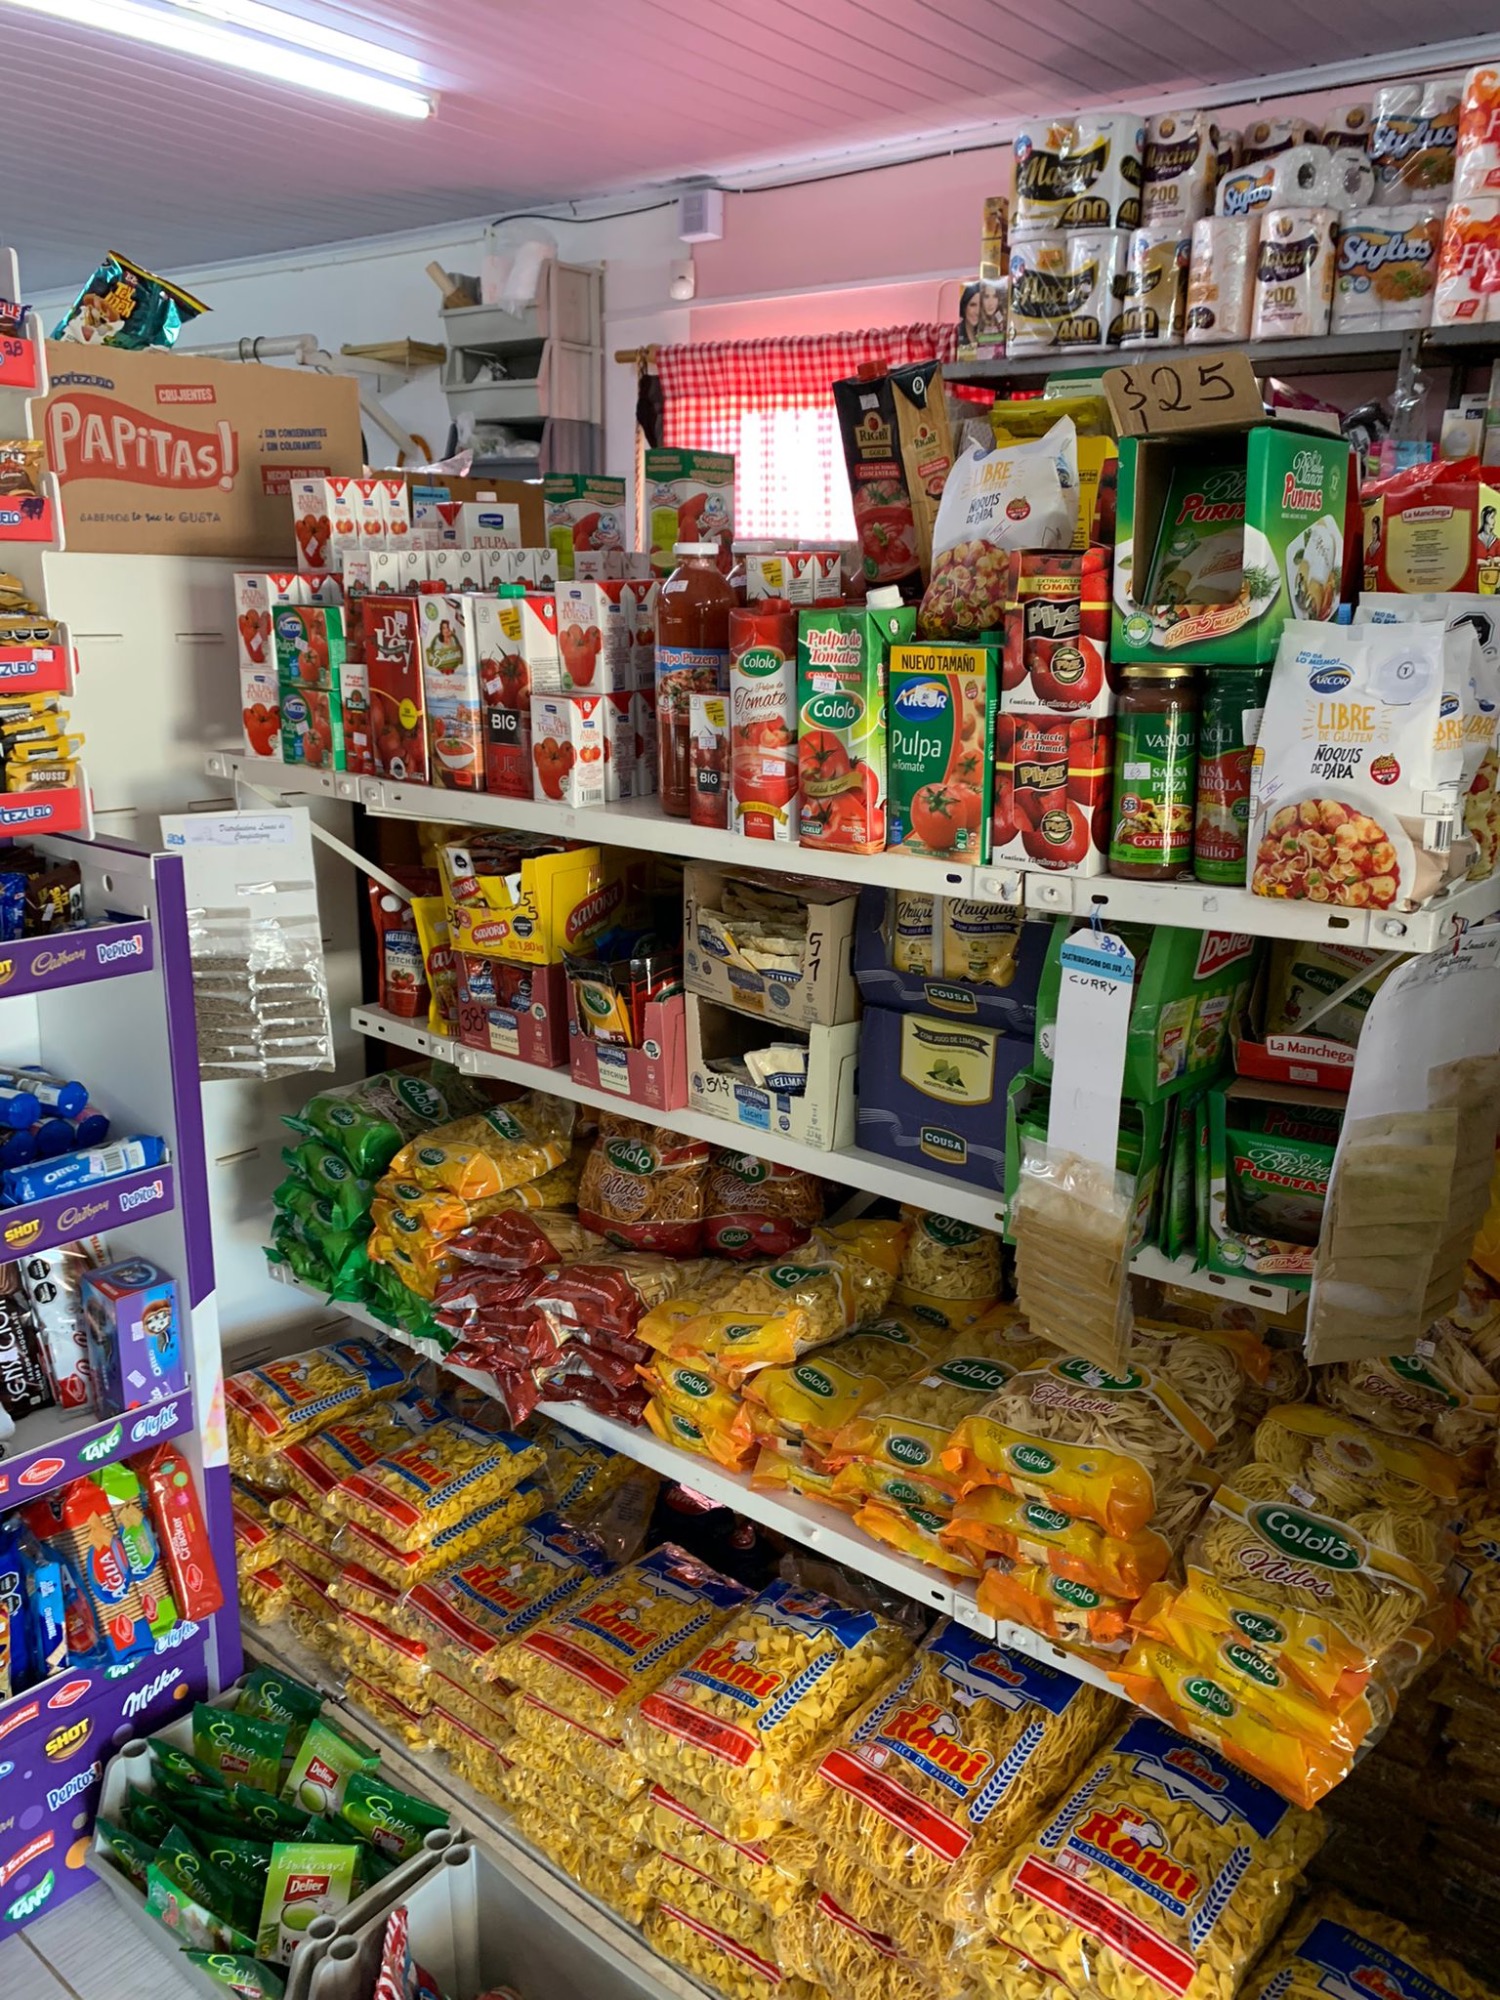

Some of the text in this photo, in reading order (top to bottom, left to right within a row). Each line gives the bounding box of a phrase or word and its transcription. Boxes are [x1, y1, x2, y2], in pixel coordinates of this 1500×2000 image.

[1149, 184, 1178, 201] 200
[1065, 200, 1108, 224] 400
[1339, 233, 1433, 271] Stylus
[1265, 286, 1297, 304] 200
[1059, 319, 1099, 341] 400
[158, 387, 214, 403] CRUJIENTES
[278, 428, 327, 437] CONSERVANTES
[280, 441, 322, 451] COLORANTES
[972, 461, 1014, 488] LIBRE
[1282, 472, 1323, 511] PURITAS
[179, 512, 222, 523] GUSTA
[806, 629, 861, 652] Pulpa de
[660, 651, 720, 666] Tipo Pizzera
[742, 652, 777, 670] Cololo
[810, 649, 860, 666] Tomates
[901, 653, 976, 673] NUEVO TAMAÑO
[1312, 674, 1351, 687] ARCOR
[735, 687, 788, 714] Tomate
[813, 699, 856, 722] Cololo
[491, 713, 518, 731] BIG
[1317, 703, 1376, 731] LIBRE
[892, 729, 942, 763] Pulpa
[1021, 743, 1067, 753] de Tomate
[1024, 731, 1064, 742] Extracto
[1318, 731, 1373, 743] DE GLUTEN
[1313, 743, 1363, 764] ÑOQUIS
[897, 759, 925, 773] Tomate
[1019, 765, 1066, 788] Pitzer
[1311, 762, 1355, 781] DE PAPA
[699, 771, 719, 785] BIG
[809, 932, 823, 957] 5
[929, 987, 971, 1003] COUSA
[1068, 974, 1118, 996] CURRY
[1269, 1039, 1354, 1064] La Manchega
[401, 1075, 441, 1118] Cololo
[924, 1132, 962, 1151] COUSA
[608, 1140, 652, 1169] Cololo
[43, 1163, 80, 1184] OREO
[325, 1156, 348, 1178] Cololo
[1233, 1155, 1328, 1195] PURITAS
[601, 1172, 647, 1198] Nidos
[5, 1218, 41, 1243] SHOT
[677, 1370, 709, 1397] Cololo
[797, 1366, 832, 1395] Cololo
[941, 1360, 1004, 1388] Cololo
[81, 1401, 179, 1461] TANG Clight
[1014, 1445, 1051, 1470] Cololo
[1027, 1502, 1066, 1526] Cololo
[1265, 1510, 1350, 1563] Cololo
[1238, 1546, 1335, 1598] Nidos
[1190, 1680, 1230, 1713] Cololo
[45, 1666, 183, 1757] SHOT Milka
[916, 1703, 943, 1722] El
[310, 1759, 336, 1788] Delier
[914, 1756, 960, 1791] DE PASTAS
[289, 1879, 324, 1896] Delier
[1079, 1842, 1176, 1910] FABRICA DE PASTAS
[9, 1881, 52, 1920] TANG
